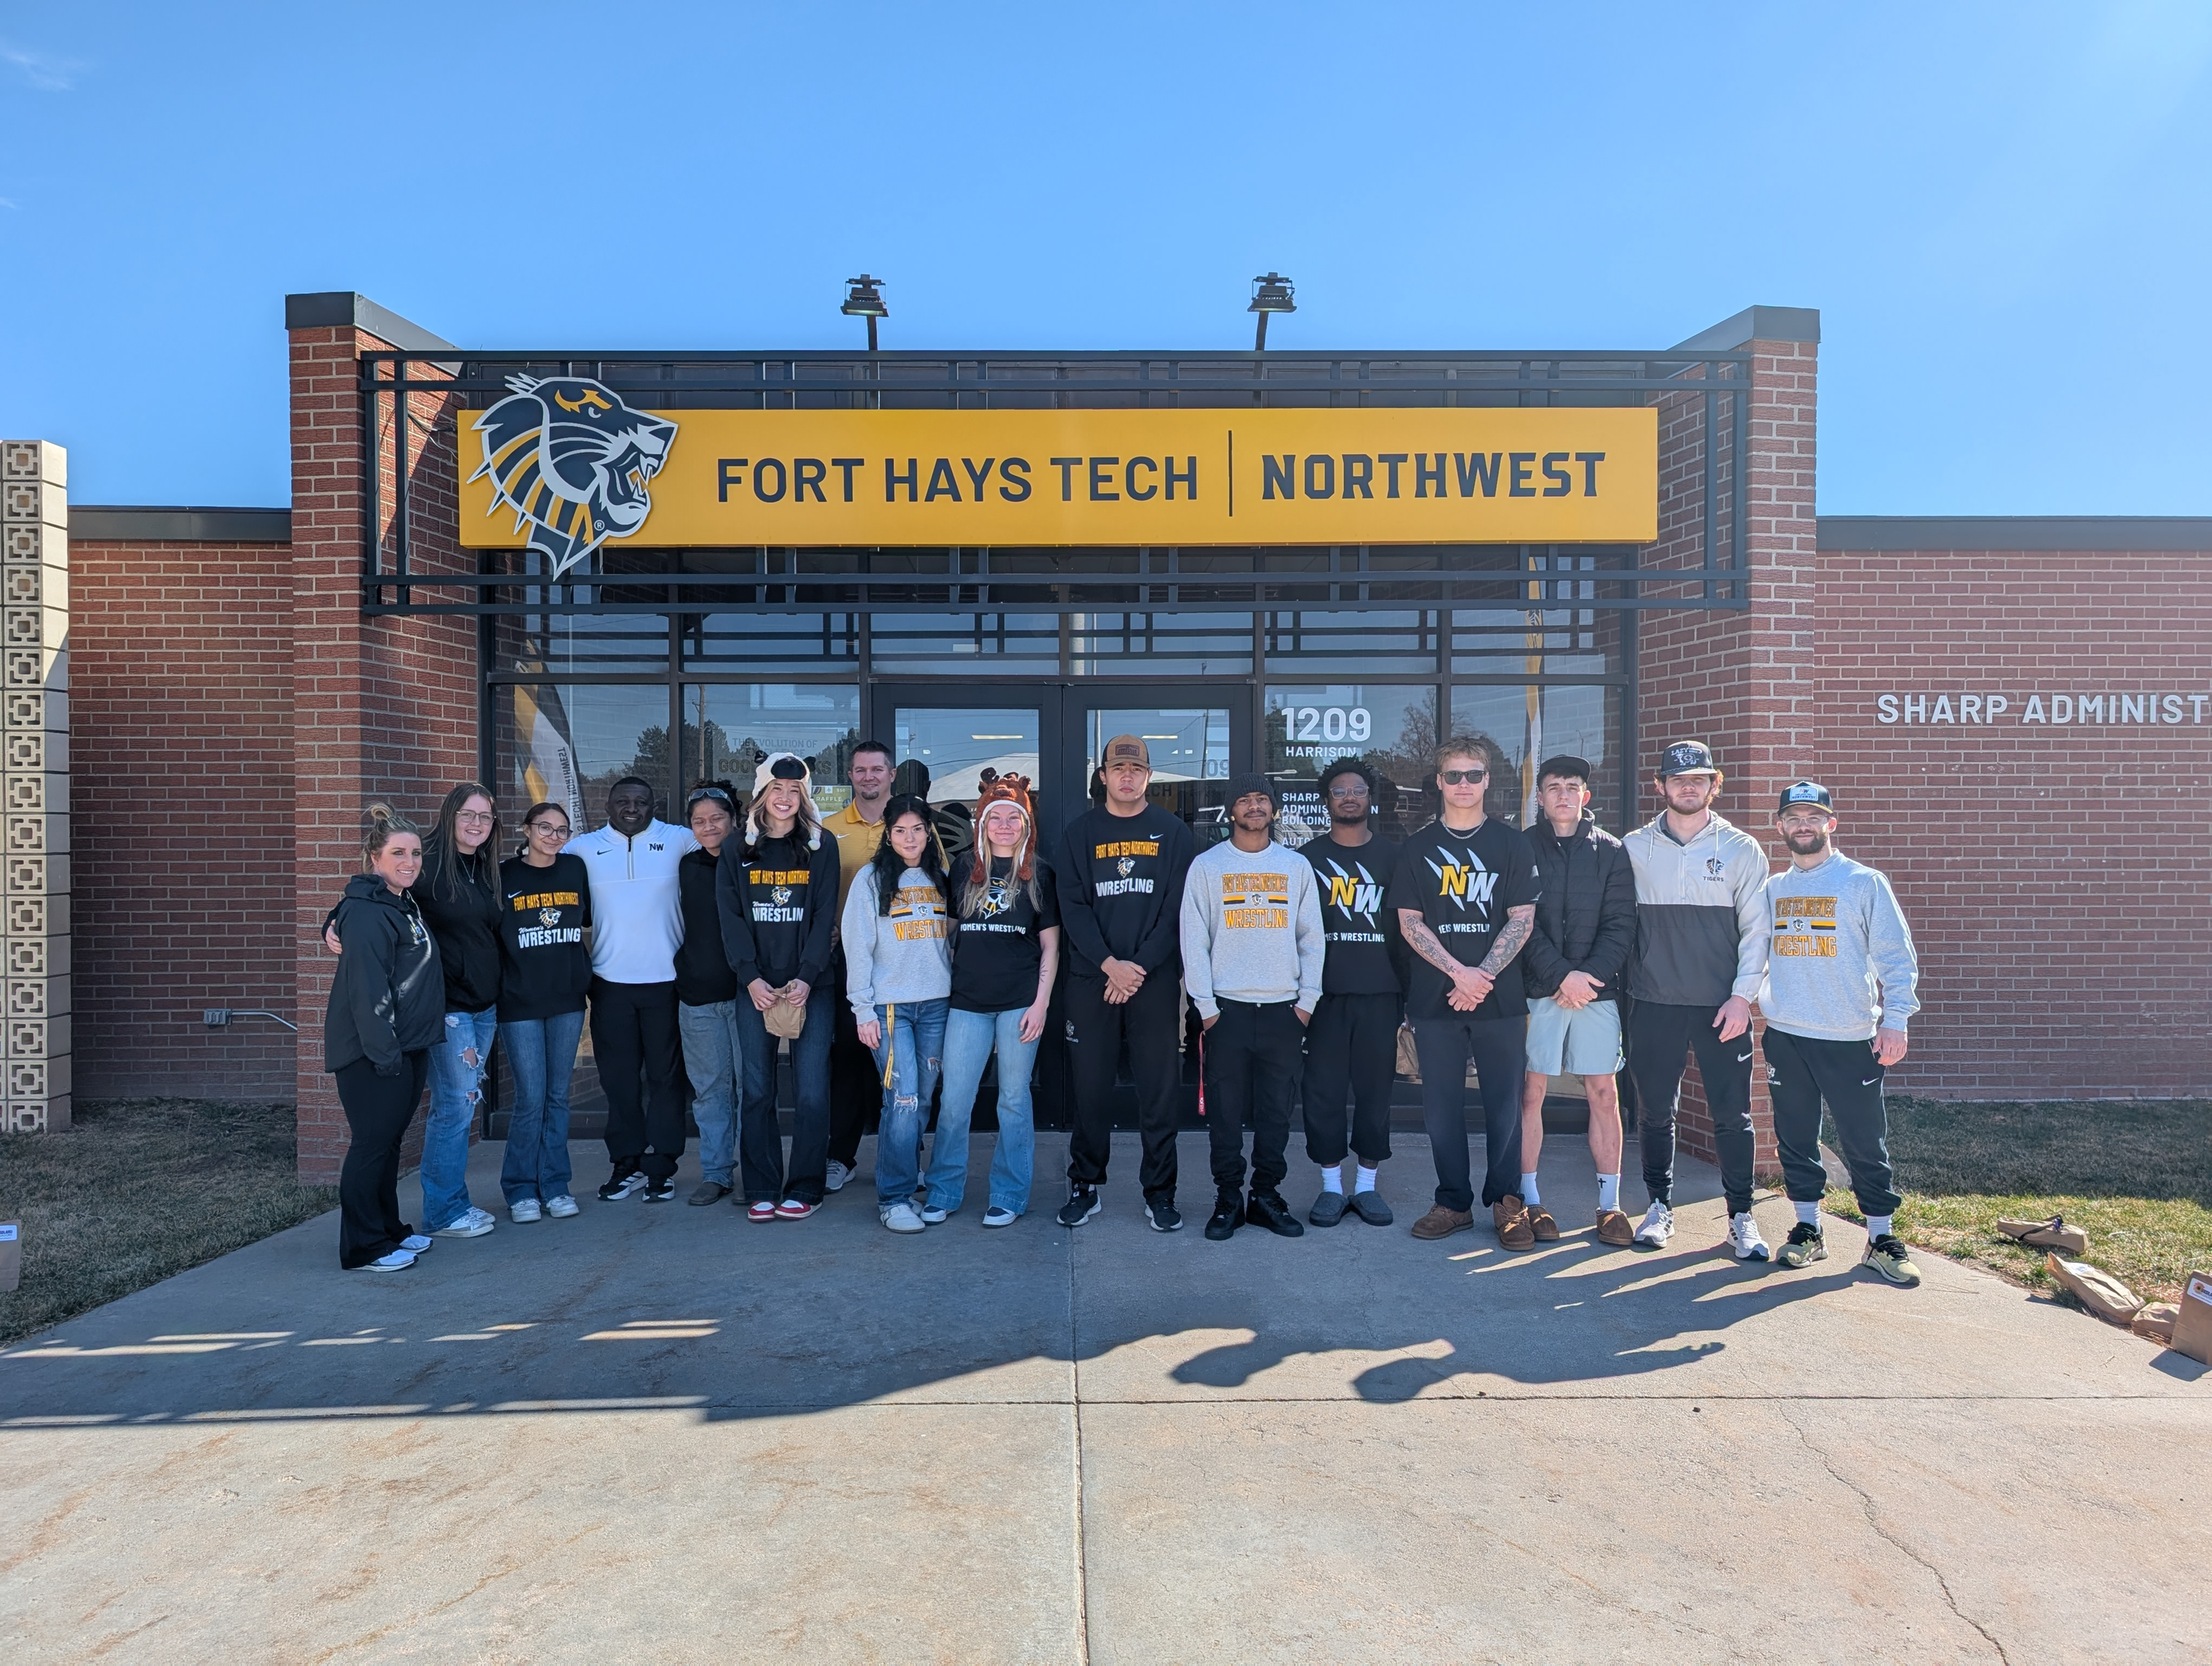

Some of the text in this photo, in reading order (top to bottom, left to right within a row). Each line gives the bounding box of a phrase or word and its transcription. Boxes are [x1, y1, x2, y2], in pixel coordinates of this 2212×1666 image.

[718, 452, 1606, 502] FORT HAYS TECH NORTHWEST
[1877, 694, 2209, 724] SHARP ADMINIST
[1281, 707, 1371, 742] 1209
[753, 738, 804, 749] EVOLUTION
[805, 739, 818, 749] OF
[1285, 746, 1357, 758] HARRISON
[1281, 792, 1320, 802] SHARP
[1281, 816, 1331, 826] BUILDING
[649, 842, 664, 852] NW
[1095, 877, 1155, 897] WRESTLING
[1439, 865, 1499, 902] NW
[1328, 876, 1384, 912] NW
[752, 907, 804, 922] WRESTLIN
[1223, 908, 1289, 930] WRESTLING
[518, 927, 581, 949] WRESTLING
[1340, 932, 1385, 943] WRESTLING
